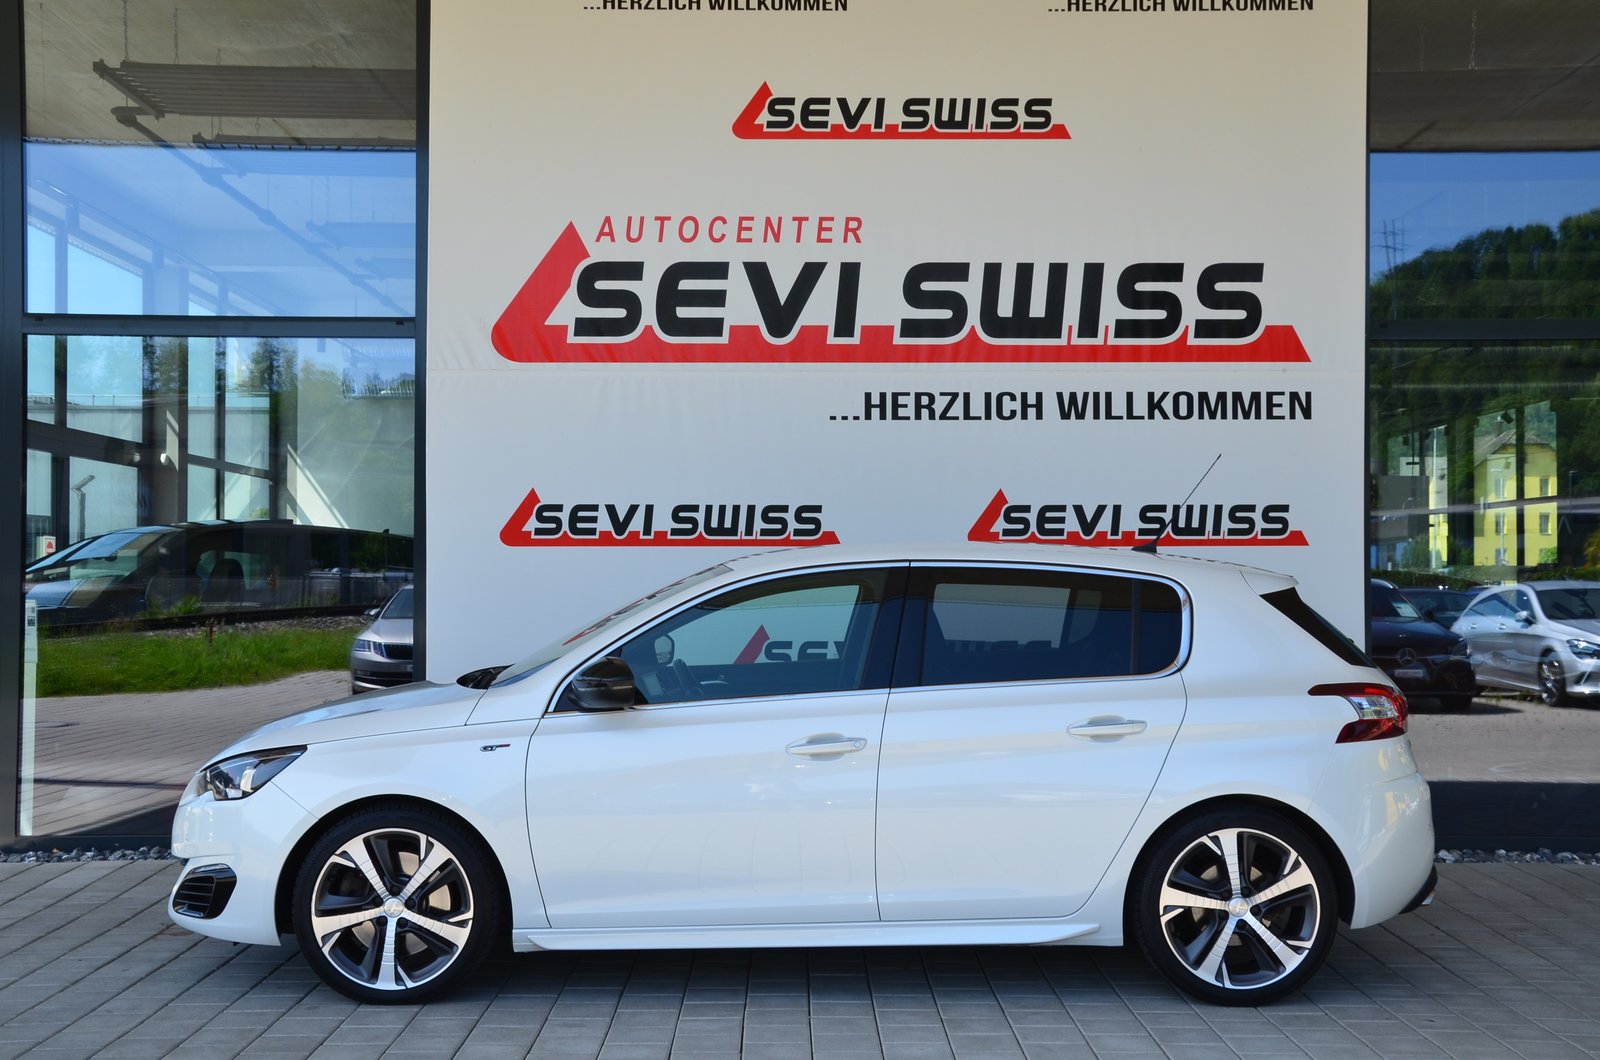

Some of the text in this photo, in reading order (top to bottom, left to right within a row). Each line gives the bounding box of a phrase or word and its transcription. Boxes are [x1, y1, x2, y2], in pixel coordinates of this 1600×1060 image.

[708, 0, 848, 12] WILLKOMMEN
[1172, 0, 1314, 12] WILLKOMMEN
[765, 97, 1053, 130] SEVI SWISS
[595, 214, 864, 245] AUTOCENTER
[573, 261, 1265, 342] SEVI SWISS
[829, 391, 1312, 421] ...HERZLICH WILLKOMMEN
[533, 503, 823, 537] SEVI SWISS
[1001, 504, 1293, 538] SEVI SWISS
